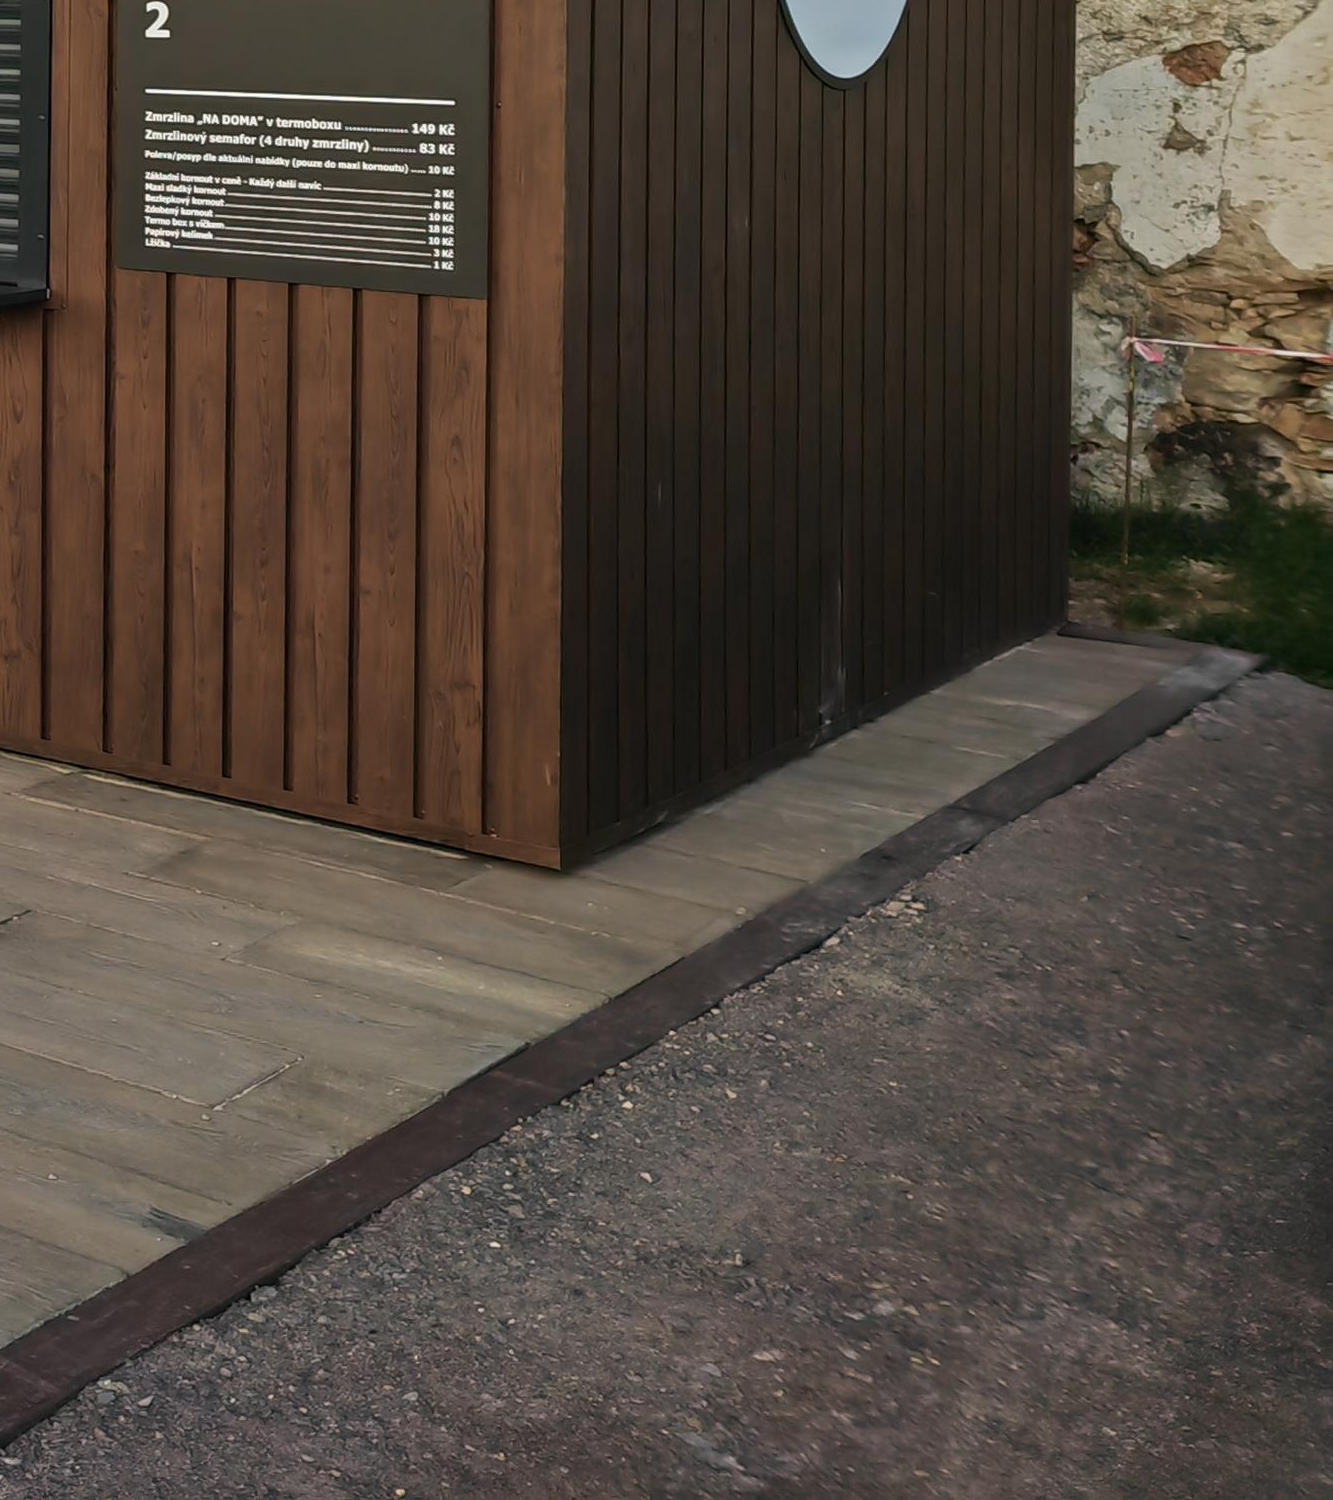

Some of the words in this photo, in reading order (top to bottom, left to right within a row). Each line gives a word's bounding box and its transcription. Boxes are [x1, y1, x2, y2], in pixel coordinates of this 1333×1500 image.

[144, 1, 171, 38] 2
[145, 111, 194, 123] Zmrzlina
[266, 119, 273, 127] v
[276, 118, 341, 130] termoboxu
[411, 123, 435, 135] 149
[439, 124, 455, 136] Kč
[145, 130, 207, 144] Zmrzlinový
[209, 134, 256, 145] semafor
[259, 135, 272, 147] (4
[275, 137, 309, 149] druhy
[312, 138, 369, 153] zmrzliny)
[419, 143, 435, 154] 83
[439, 144, 455, 155] Kč
[292, 158, 322, 168] (pouze
[324, 160, 336, 168] do
[338, 162, 360, 170] maxi
[428, 166, 440, 174] 10
[443, 166, 455, 175] Kč
[434, 189, 440, 197] 2
[442, 189, 454, 198] Kč
[442, 201, 454, 211] Kč
[428, 213, 440, 221] 10
[442, 213, 454, 222] Kč
[442, 225, 454, 234] Kč
[442, 237, 454, 246] Kč
